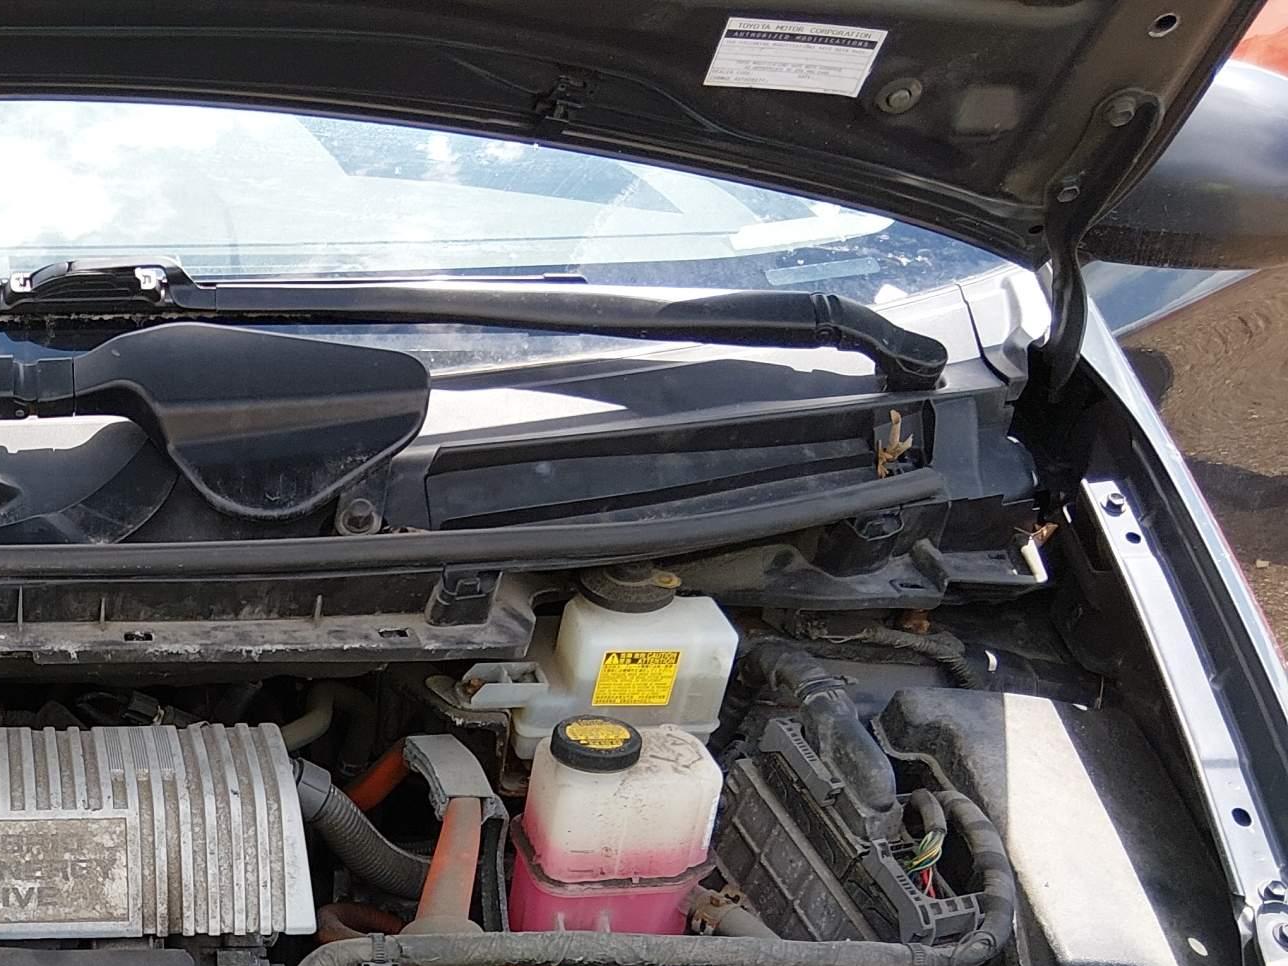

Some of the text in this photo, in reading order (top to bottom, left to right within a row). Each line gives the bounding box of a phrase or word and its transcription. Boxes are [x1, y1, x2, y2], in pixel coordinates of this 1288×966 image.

[733, 31, 790, 41] AUTHORIZED
[795, 35, 870, 47] MODIFICATIONS
[738, 22, 872, 40] TOYOTA MOTOR CORPORATION
